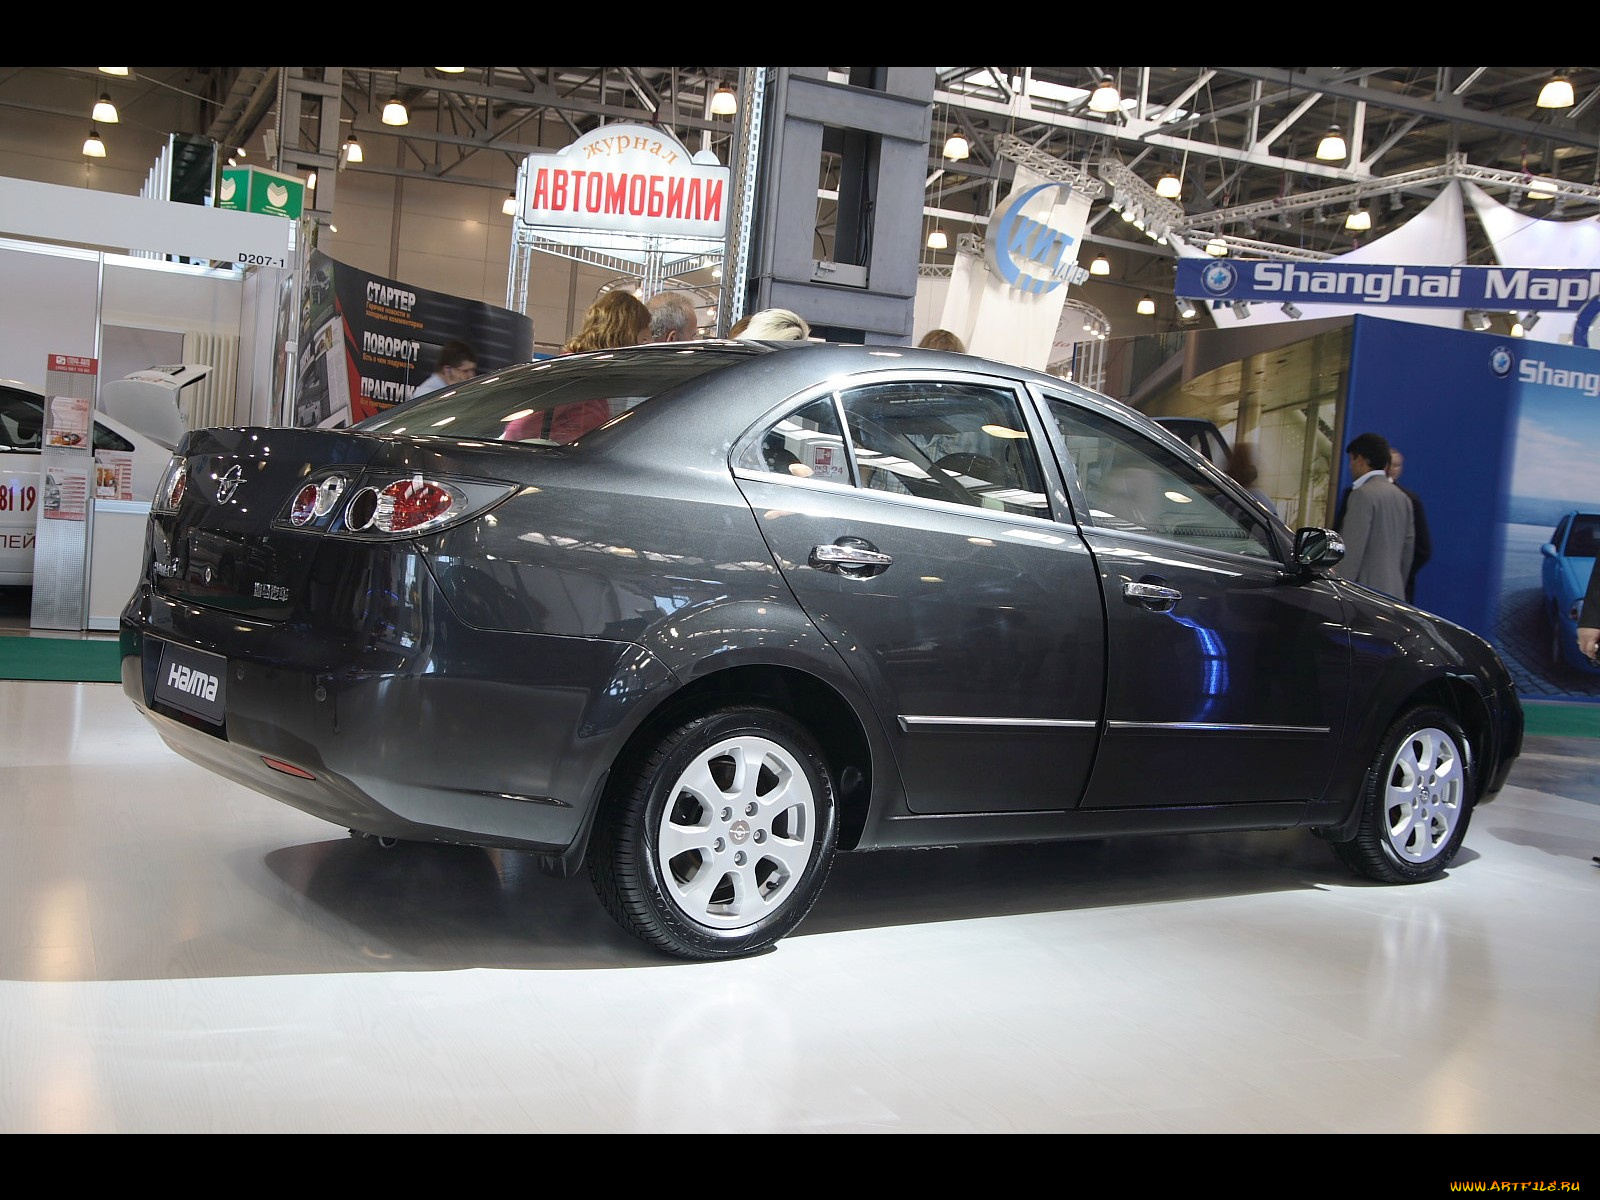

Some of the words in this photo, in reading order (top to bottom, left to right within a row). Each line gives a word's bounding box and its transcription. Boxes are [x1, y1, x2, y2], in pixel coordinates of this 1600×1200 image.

[584, 135, 679, 166] журнал
[532, 168, 724, 222] АВТОМОБИЛИ
[238, 252, 285, 268] D207-1
[366, 281, 417, 312] СТАРТЕР
[1253, 262, 1462, 303] Shanghai
[363, 331, 420, 361] ПОВОРОТ
[361, 376, 420, 403] ПРАКТИК
[1518, 358, 1600, 397] Shang
[20, 486, 36, 512] 19
